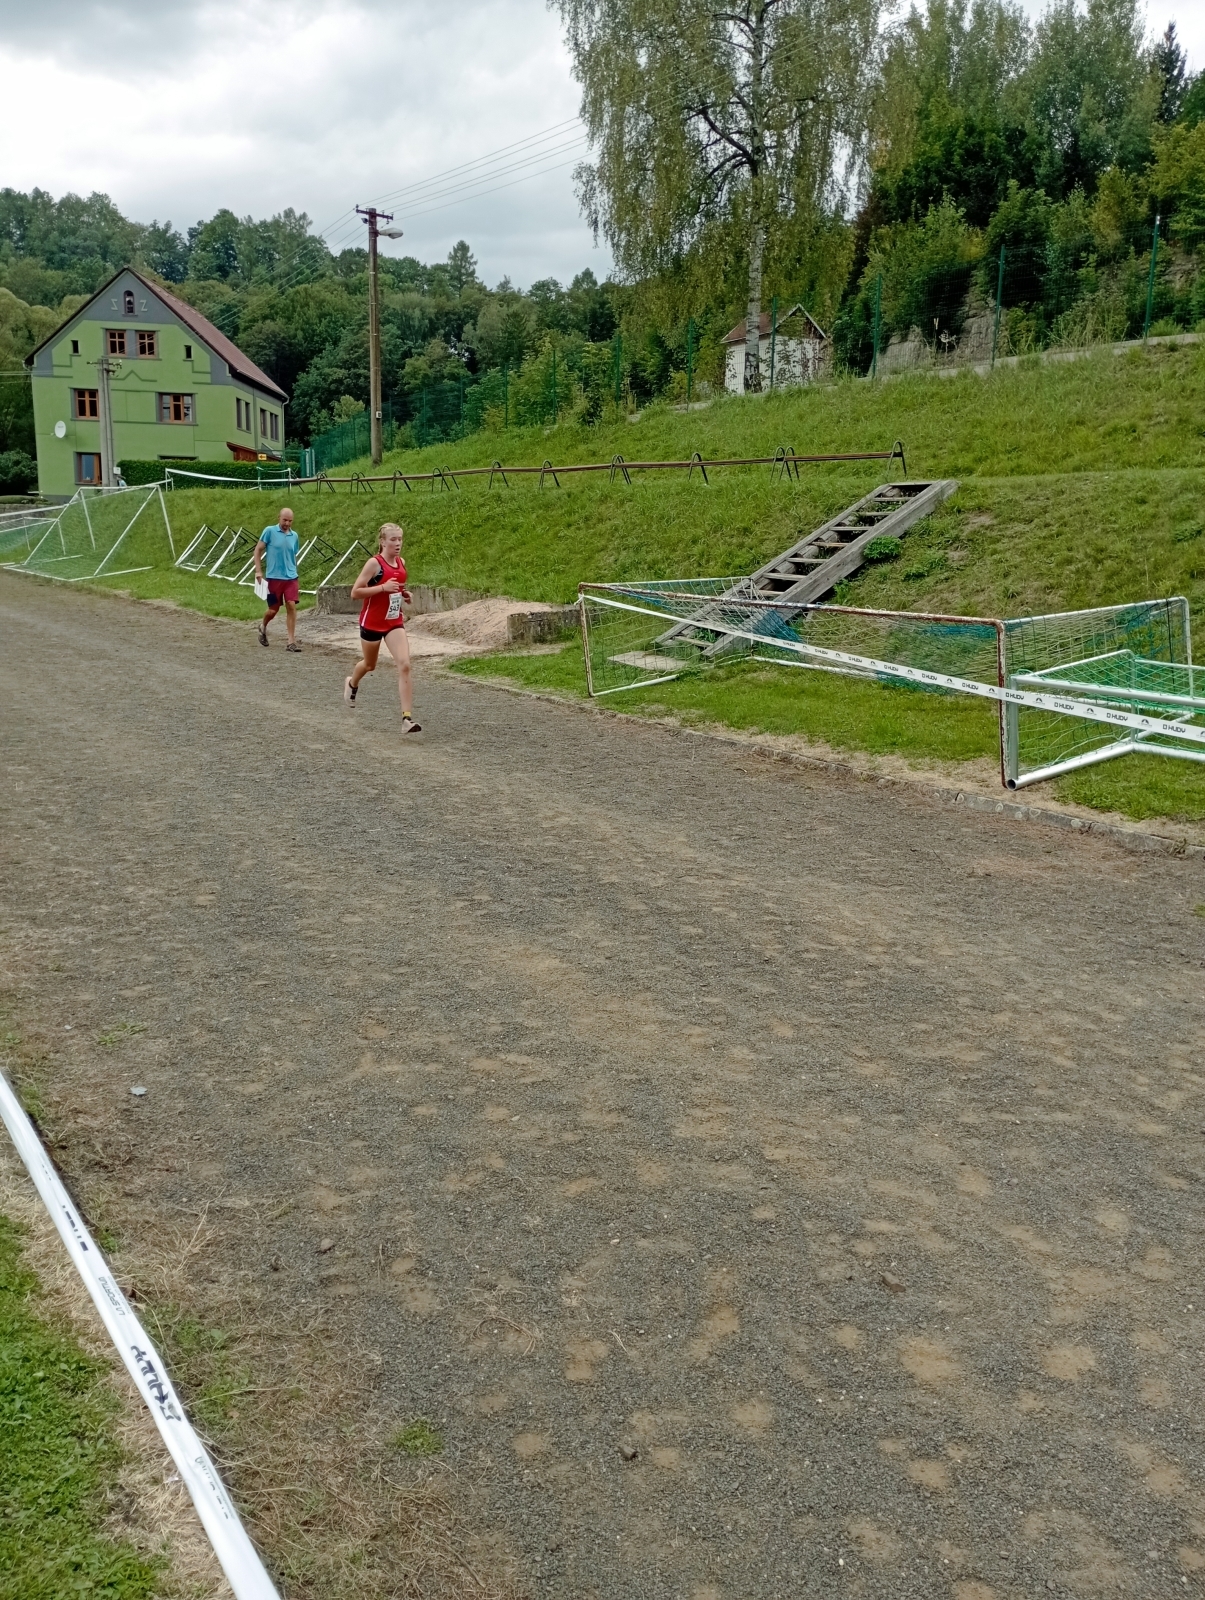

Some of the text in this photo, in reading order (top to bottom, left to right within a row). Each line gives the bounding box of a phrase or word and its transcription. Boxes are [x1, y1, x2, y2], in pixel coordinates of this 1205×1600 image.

[1010, 693, 1025, 701] HUDY
[1058, 703, 1075, 711] HUDY
[1112, 713, 1129, 722] HUDY
[1168, 725, 1186, 734] HUDY
